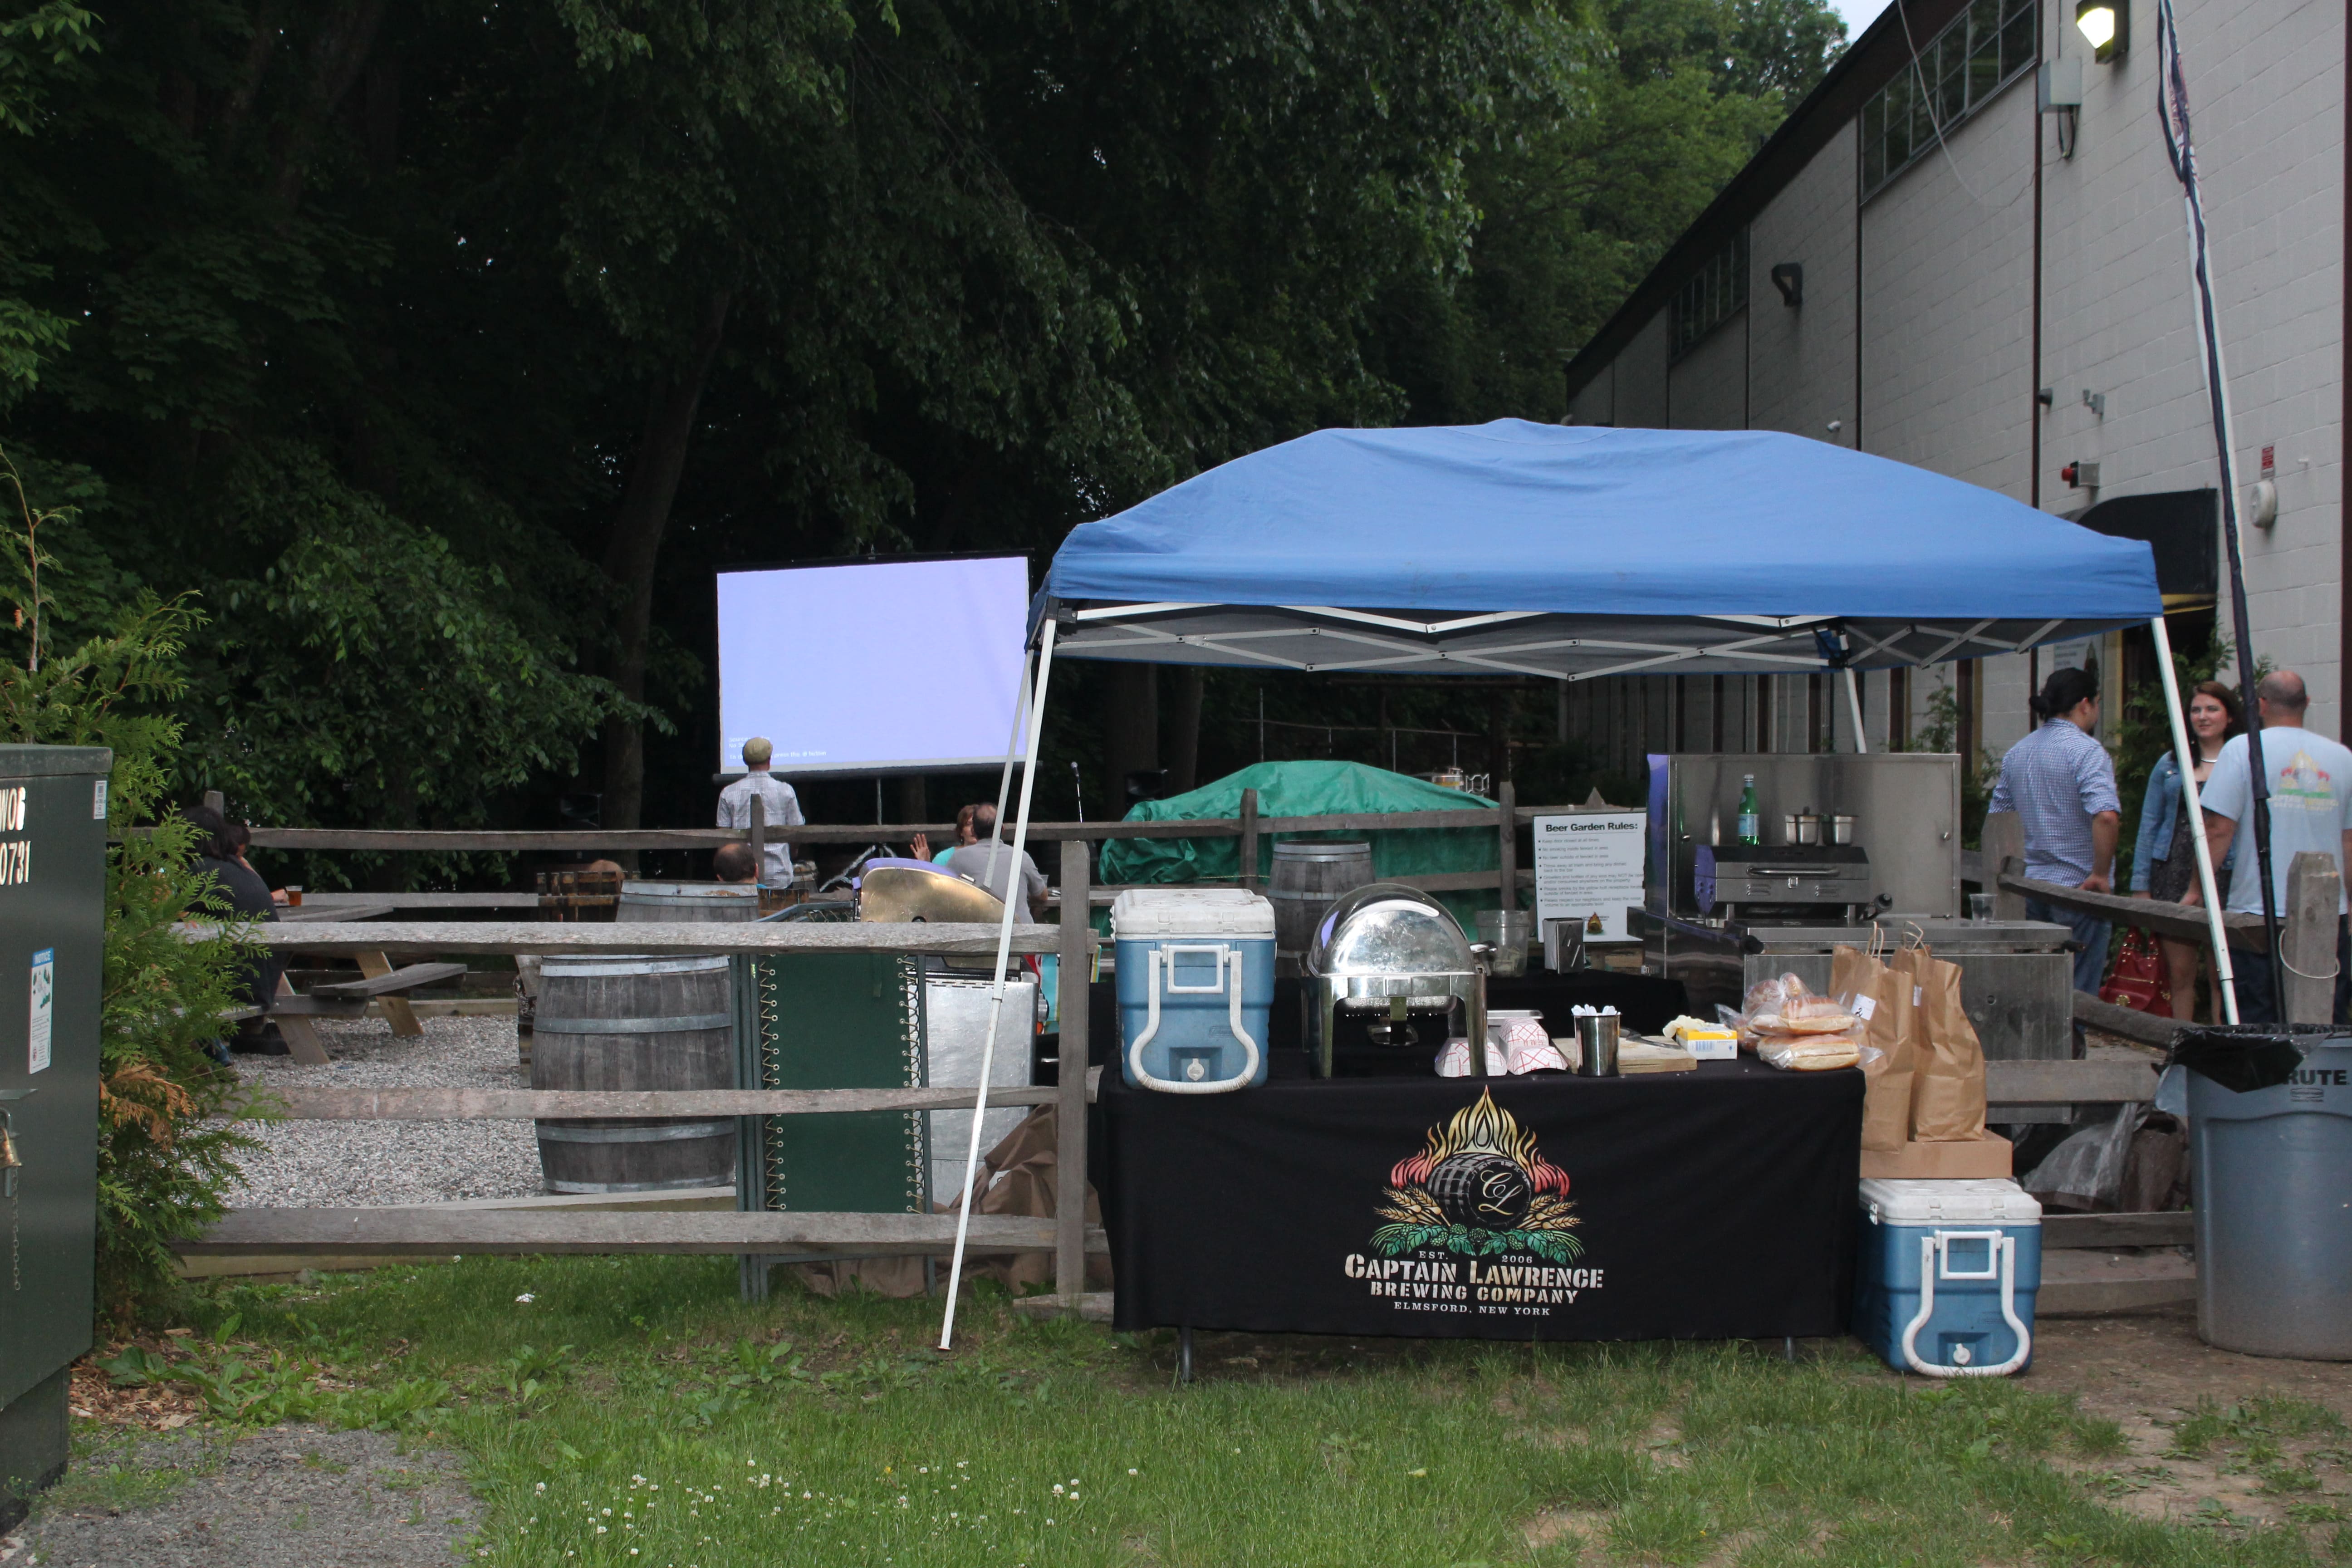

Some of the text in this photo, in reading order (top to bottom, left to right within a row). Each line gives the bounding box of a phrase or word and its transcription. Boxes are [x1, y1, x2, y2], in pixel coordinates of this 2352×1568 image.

[1571, 823, 1605, 831] Garden
[2283, 1070, 2347, 1085] RUTE
[1419, 1250, 1533, 1264] EST. 2006
[1345, 1253, 1604, 1289] CAPTAIN LAWRENCE
[1370, 1281, 1578, 1304] BREWING COMPANY
[1394, 1301, 1551, 1316] ELMSFORD, NEW YORK
